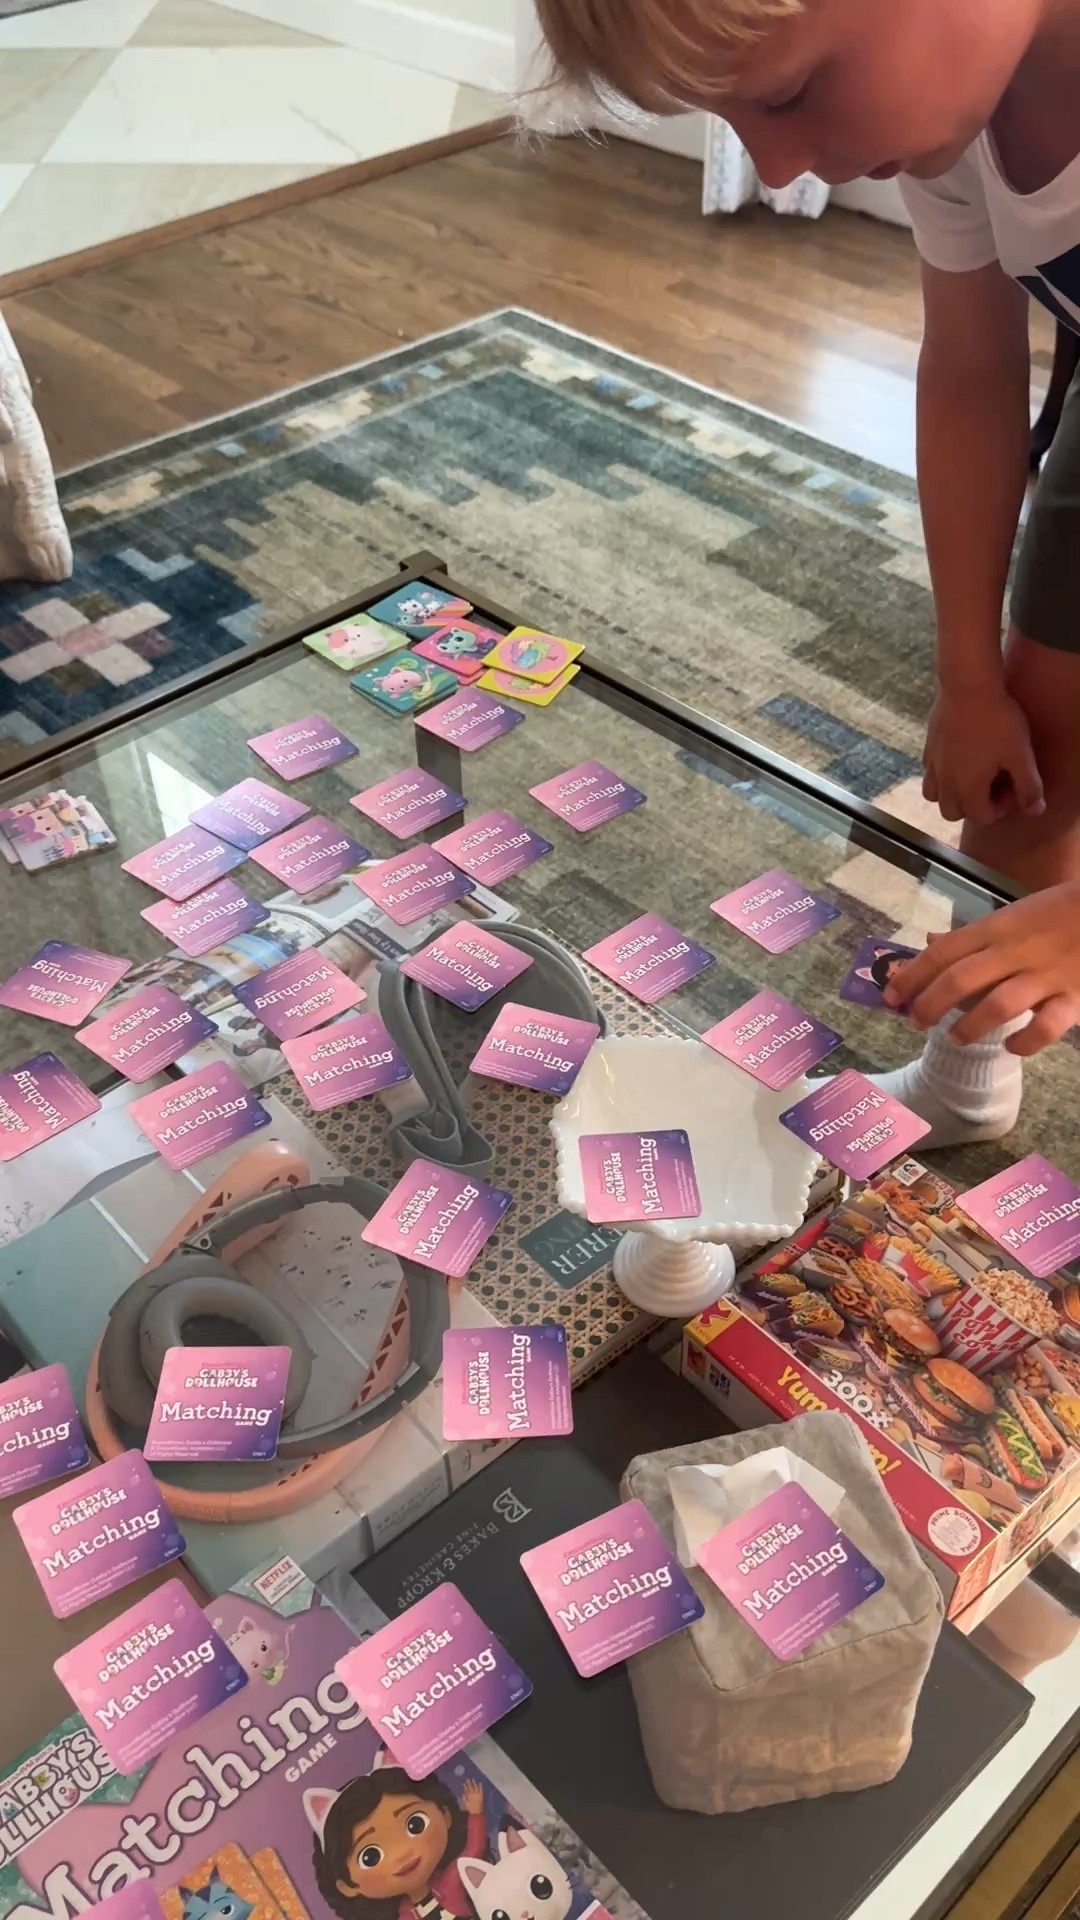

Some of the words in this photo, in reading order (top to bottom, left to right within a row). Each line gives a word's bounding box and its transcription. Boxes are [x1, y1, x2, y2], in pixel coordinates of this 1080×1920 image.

[446, 705, 505, 740] Matching
[272, 736, 341, 767] Matching
[218, 801, 271, 835] Matching
[380, 788, 447, 824] Matching
[559, 782, 626, 816] Matching
[153, 845, 225, 887] Matching
[280, 840, 350, 879] Matching
[464, 831, 531, 870] Matching
[383, 870, 455, 907] Matching
[172, 898, 248, 938] Matching
[746, 896, 816, 935] Matching
[32, 959, 109, 994] Matching
[426, 946, 494, 992] Matching
[619, 941, 690, 985] Matching
[254, 965, 335, 1010] Matching
[112, 1010, 193, 1064] Matching
[488, 1037, 575, 1073] Matching
[742, 1020, 814, 1070] Matching
[304, 1049, 394, 1088] Matching
[13, 1071, 68, 1129] Matching
[156, 1095, 249, 1145] Matching
[809, 1091, 887, 1141] Matching
[636, 1137, 663, 1214] Matching
[414, 1184, 479, 1259] Matching
[184, 1377, 258, 1388] DOLLHOUSE
[199, 1368, 249, 1378] GABBY'S
[468, 1360, 479, 1404] GABBY'S
[478, 1351, 490, 1415] DOLLHOUSE
[505, 1334, 531, 1431] Matching
[823, 1370, 873, 1413] 300
[0, 1400, 44, 1424] HOUSE
[160, 1401, 272, 1426] Matching
[0, 1421, 70, 1456] ching
[50, 1489, 127, 1535] DOLLHOUSE
[60, 1488, 112, 1518] GABBY'S
[42, 1507, 161, 1577] Matching
[454, 1522, 499, 1560] BAKES
[568, 1538, 617, 1568] GABBY'S
[737, 1524, 803, 1575] DOLLHOUSE
[742, 1522, 786, 1557] GABBY'S
[560, 1542, 634, 1586] DOLLHOUSE
[743, 1543, 848, 1620] Matching
[398, 1567, 445, 1608] KROPP
[557, 1565, 672, 1631] Matching
[98, 1623, 174, 1683] DOLLHOUSE
[105, 1623, 157, 1663] GABBY'S
[379, 1630, 453, 1689] DOLLHOUSE
[386, 1629, 435, 1669] GABBY'S
[95, 1640, 215, 1730] Matching
[381, 1648, 496, 1737] Matching
[0, 1730, 95, 1826] ABBY'S
[284, 1732, 338, 1783] GAME
